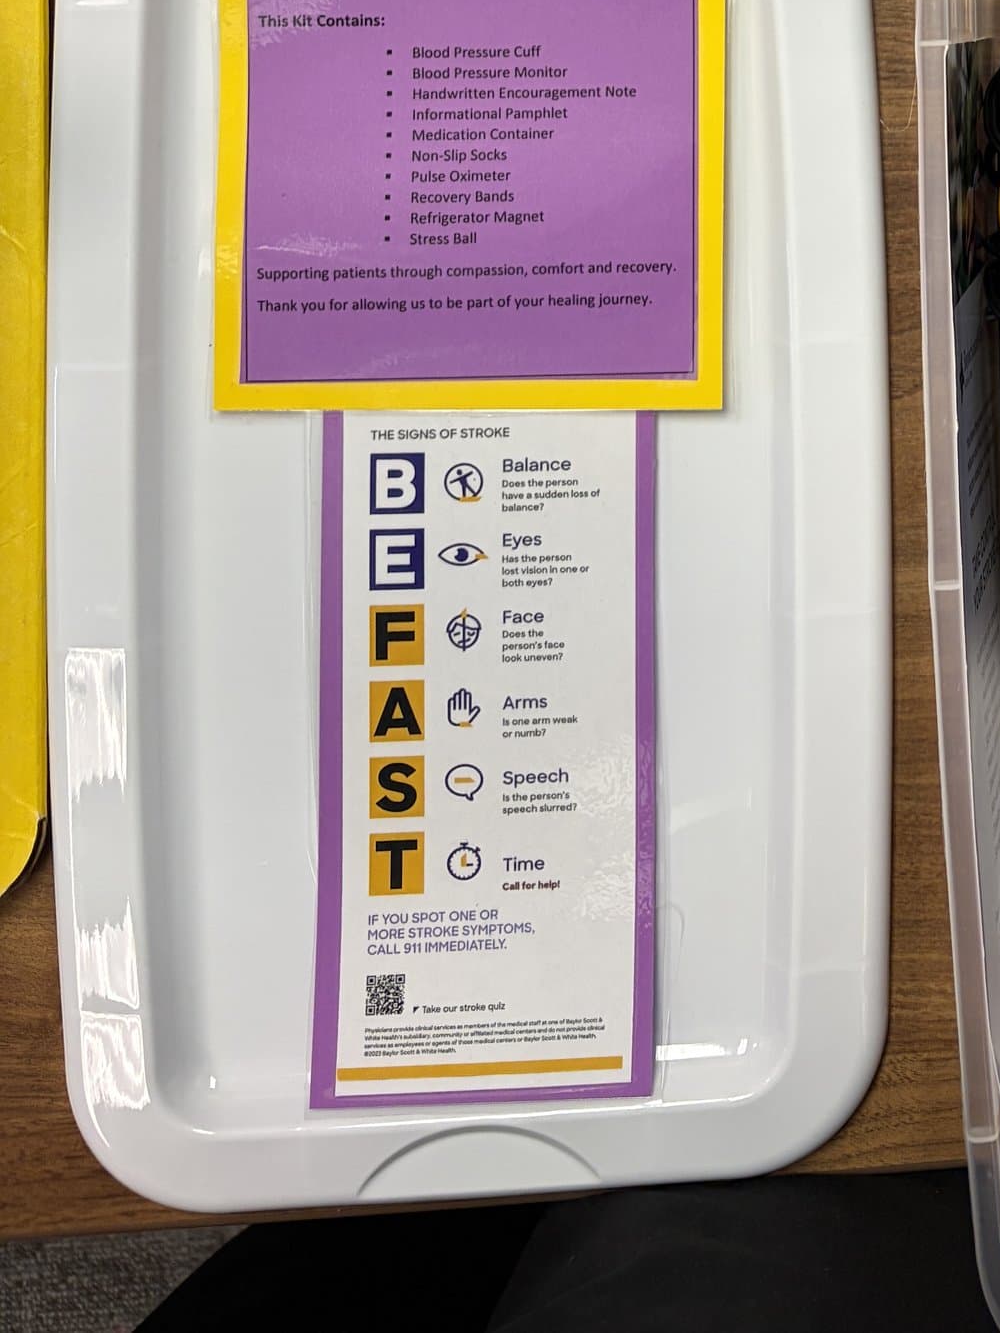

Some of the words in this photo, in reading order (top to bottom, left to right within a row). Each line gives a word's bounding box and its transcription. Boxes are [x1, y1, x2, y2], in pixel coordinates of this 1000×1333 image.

[257, 14, 289, 28] This
[292, 14, 313, 28] Kit
[316, 13, 385, 28] Contains:
[412, 45, 450, 59] Blood
[454, 46, 511, 59] Pressure
[513, 45, 541, 58] Cuff
[412, 66, 450, 80] Blood
[454, 67, 511, 79] Pressure
[514, 66, 568, 78] Monitor
[412, 87, 495, 100] Handwritten
[499, 86, 601, 101] Encouragement
[605, 85, 637, 98] Note
[412, 106, 502, 121] Informational
[505, 106, 568, 122] Pamphlet
[412, 128, 486, 142] Medication
[489, 127, 555, 140] Container
[411, 148, 467, 164] Non-Slip
[470, 148, 508, 161] Socks
[411, 170, 446, 183] Pulse
[449, 169, 511, 183] Oximeter
[411, 191, 472, 206] Recovery
[475, 189, 515, 203] Bands
[410, 211, 491, 227] Refrigerator
[494, 210, 545, 226] Magnet
[409, 233, 450, 246] Stress
[453, 231, 477, 245] Ball
[256, 266, 330, 283] Supporting
[333, 266, 387, 282] patients
[390, 264, 443, 280] through
[446, 263, 528, 280] compassion,
[531, 262, 585, 276] comfort
[587, 261, 612, 274] and
[616, 262, 677, 276] recovery.
[370, 429, 395, 441] THE
[397, 428, 437, 440] SIGNS
[439, 428, 458, 440] OF
[460, 426, 510, 439] STROKE
[502, 457, 572, 473] Balance
[375, 459, 416, 509] B
[501, 479, 526, 488] Does
[527, 478, 544, 488] the
[545, 479, 579, 489] person
[501, 491, 525, 500] have
[526, 492, 533, 500] a
[534, 490, 570, 500] sudden
[570, 489, 589, 499] loss
[590, 488, 601, 498] of
[501, 502, 545, 513] balance?
[502, 533, 542, 551] Eyes
[375, 534, 415, 585] E
[502, 610, 545, 624] Face
[375, 611, 415, 661] F
[502, 696, 548, 710] Arms
[373, 687, 422, 737] A
[502, 767, 569, 789] Speech
[376, 762, 417, 812] S
[375, 839, 418, 890] T
[503, 856, 545, 872] Time
[502, 881, 520, 891] Call
[521, 880, 536, 890] for
[537, 879, 561, 891] help!
[368, 914, 379, 926] IF
[382, 913, 409, 925] YOU
[411, 911, 446, 924] SPOT
[448, 910, 477, 922] ONE
[479, 909, 499, 921] OR
[367, 927, 405, 941] MORE
[407, 925, 459, 939] STROKE
[461, 922, 536, 937] SYMPTOMS,
[367, 943, 401, 956] CALL
[403, 942, 422, 954] 911
[424, 938, 507, 954] IMMEDIATELY.
[422, 1004, 442, 1014] Take
[442, 1005, 458, 1013] our
[459, 1002, 487, 1012] stroke
[487, 1001, 506, 1012] quiz
